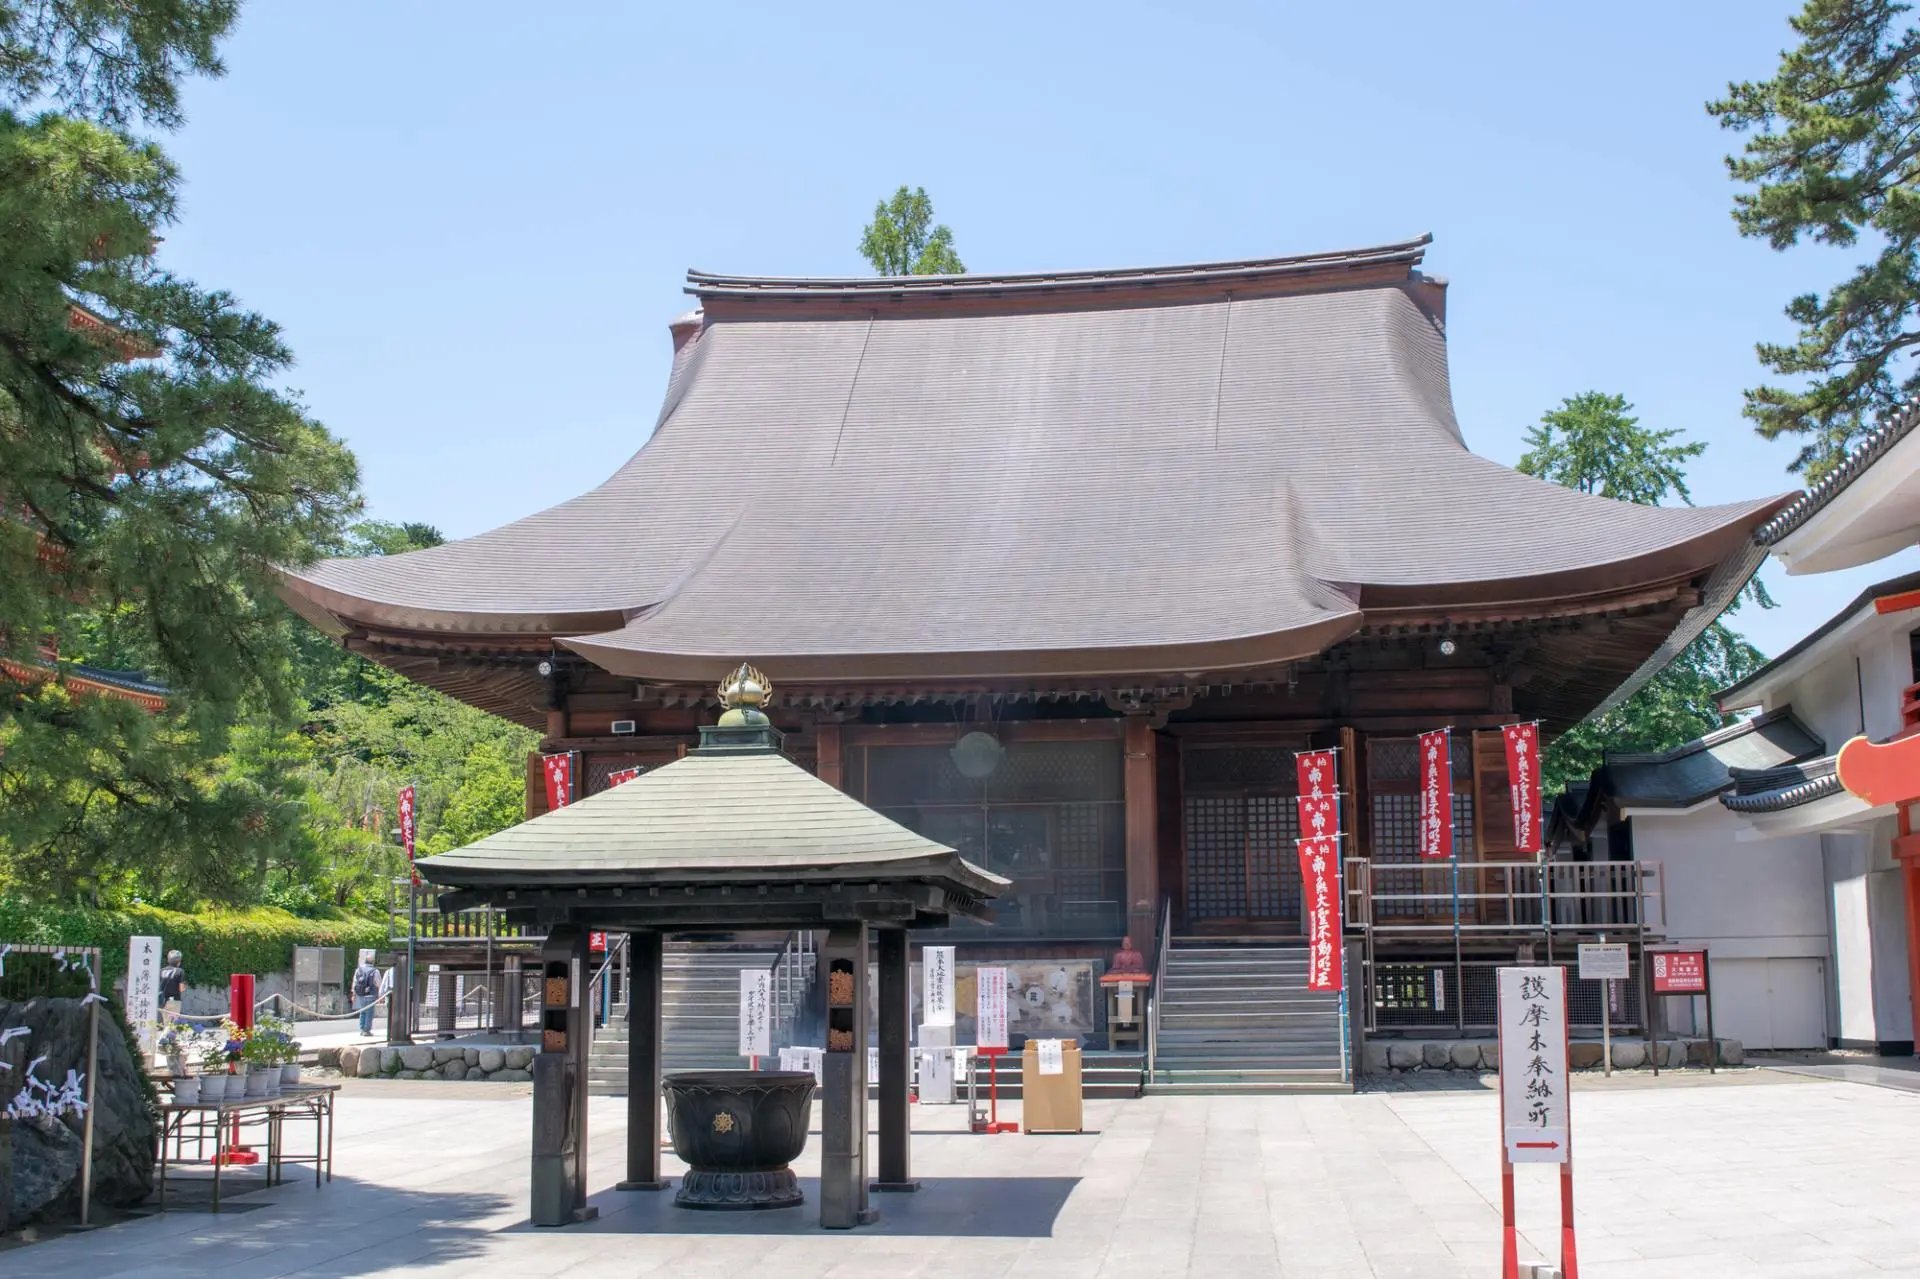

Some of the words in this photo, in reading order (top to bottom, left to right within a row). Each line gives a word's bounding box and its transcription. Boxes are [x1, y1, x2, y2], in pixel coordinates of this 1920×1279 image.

[1303, 757, 1326, 767] 奉納
[1305, 801, 1330, 812] 奉納
[1427, 746, 1440, 854] 南無大聖不動明王
[1516, 739, 1531, 848] 南無大聖不動明王
[1304, 844, 1329, 856] 奉納
[1312, 855, 1332, 986] 南無大聖不動明王
[1519, 976, 1553, 1128] 護摩木奉納所
